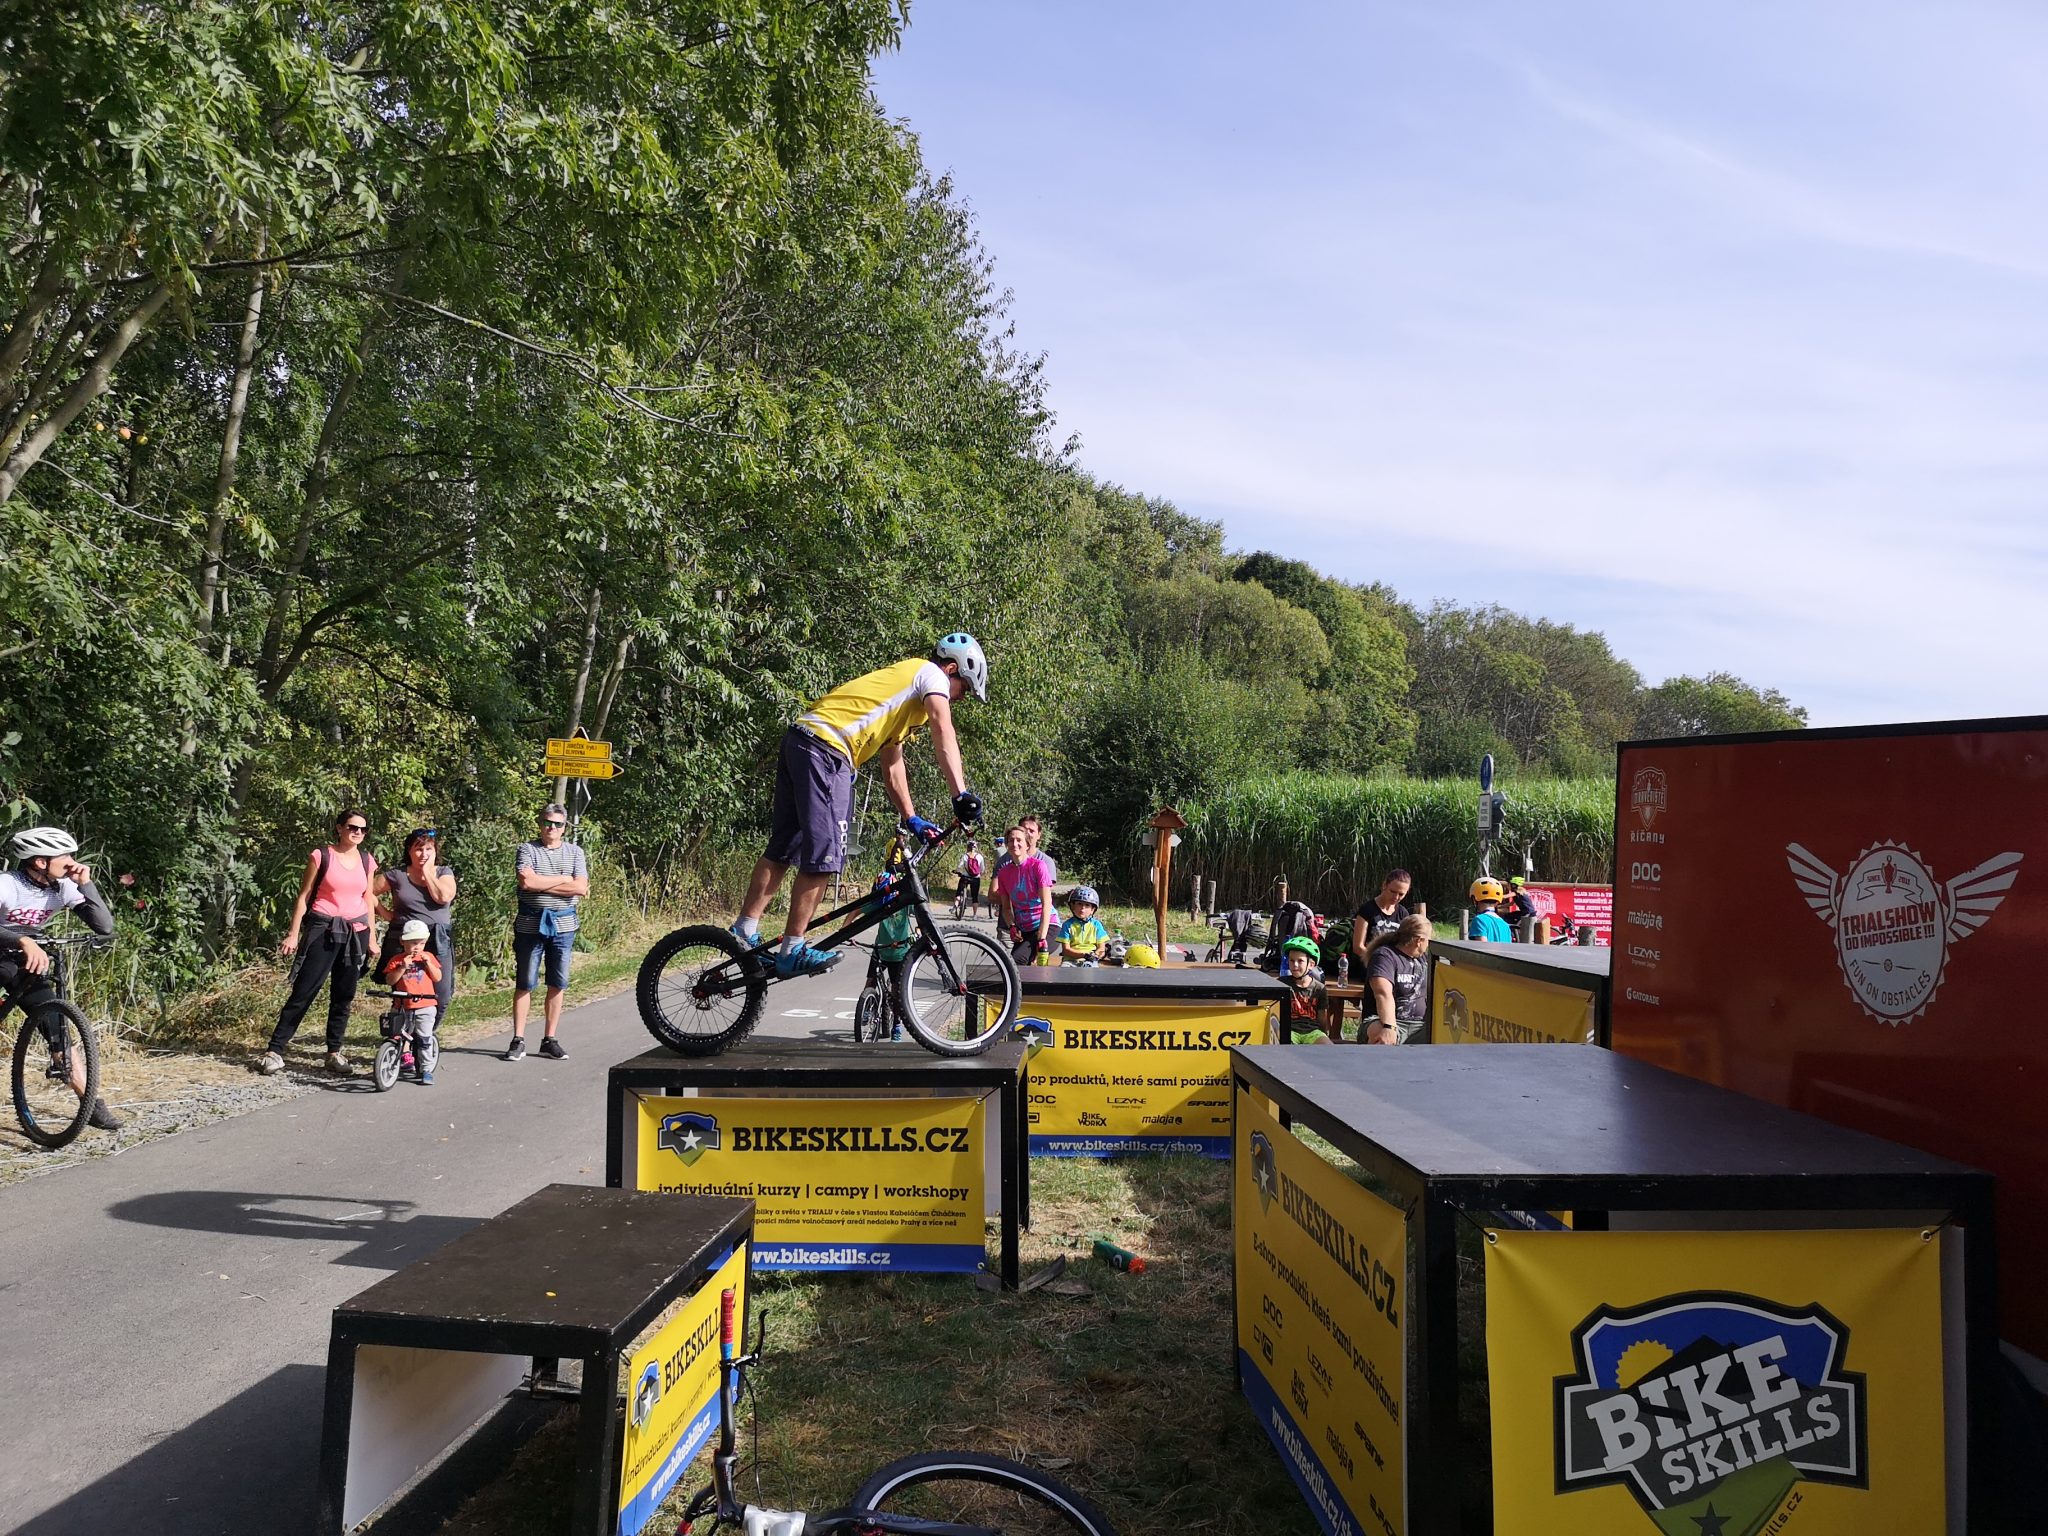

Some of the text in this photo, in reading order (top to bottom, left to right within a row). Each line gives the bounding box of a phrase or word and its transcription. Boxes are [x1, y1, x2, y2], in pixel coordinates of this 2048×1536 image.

[1841, 900, 1936, 937] TRIALSHOW
[1845, 936, 1859, 951] DO
[1861, 925, 1922, 949] IMPOSSIBLE
[1628, 944, 1660, 960] LEZYNE
[1849, 959, 1931, 1007] FUN ON OBSTACLES
[1049, 1073, 1109, 1087] produktů,
[1112, 1075, 1144, 1086] které
[1146, 1076, 1178, 1087] sami
[1180, 1075, 1230, 1088] používá
[1106, 1096, 1147, 1105] LEZYNE
[732, 1126, 969, 1153] BIKESKILLS.CZ
[1048, 1140, 1203, 1153] www.bikeskills.cz/shop
[658, 1181, 754, 1197] individuální
[757, 1183, 801, 1199] kurzy
[814, 1184, 870, 1200] campy
[883, 1182, 969, 1201] workshopy
[802, 1218, 845, 1226] volnočasový
[900, 1219, 920, 1227] Prahy
[807, 1208, 834, 1216] TRIALU
[751, 1248, 891, 1265] ww.bikeskills.cz
[1253, 1231, 1276, 1272] E-shop
[1280, 1171, 1399, 1328] BIKESKILLS.CZ
[664, 1306, 721, 1395] BIKESKILL
[1585, 1334, 1801, 1471] BIKE
[1661, 1393, 1841, 1495] SKILLS
[1272, 1405, 1353, 1536] www.bikeskills.cz/sh
